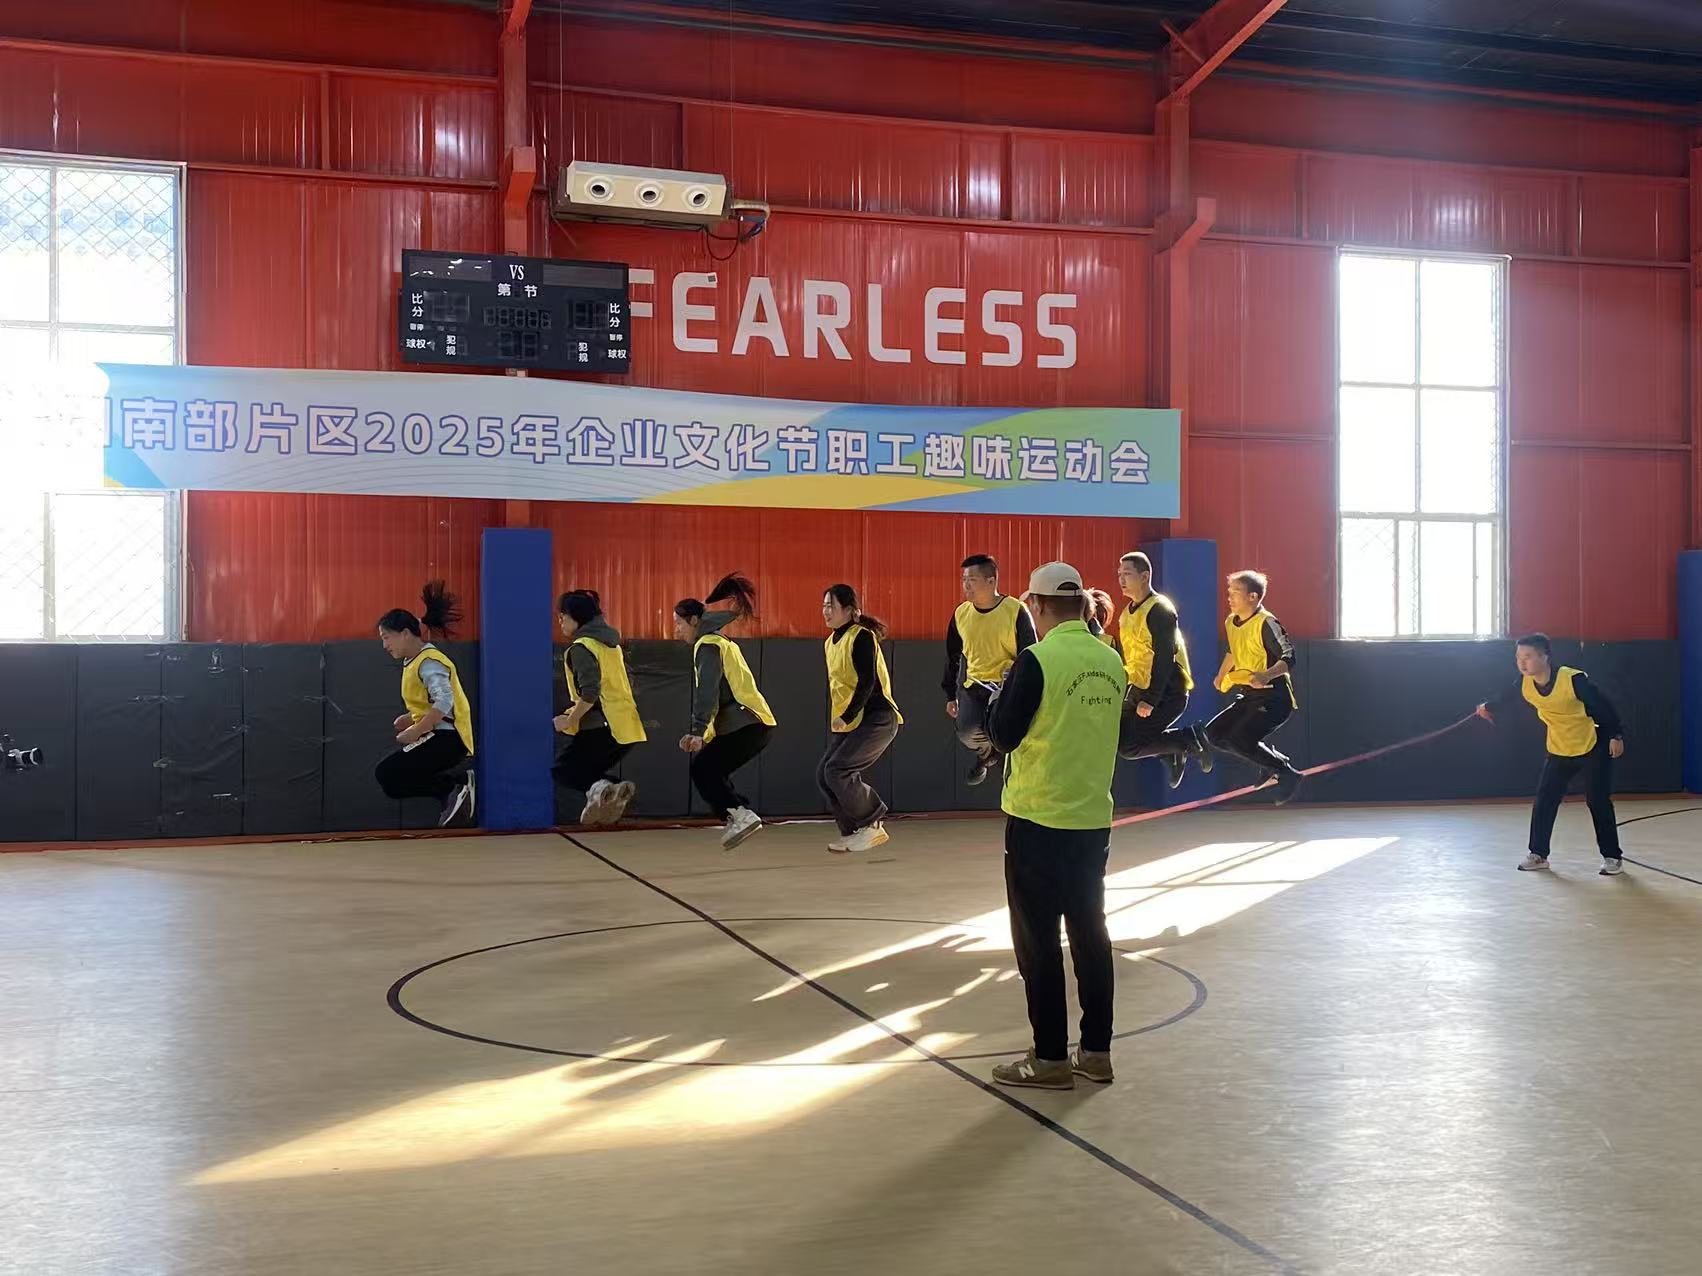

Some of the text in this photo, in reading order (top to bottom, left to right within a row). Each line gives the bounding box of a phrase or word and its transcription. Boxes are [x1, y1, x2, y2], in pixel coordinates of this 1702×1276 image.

[509, 264, 525, 280] VS
[406, 338, 426, 350] 球权
[607, 348, 627, 359] 球权
[104, 396, 1150, 485] 南部片区2025年企业文化节职工趣味运动会
